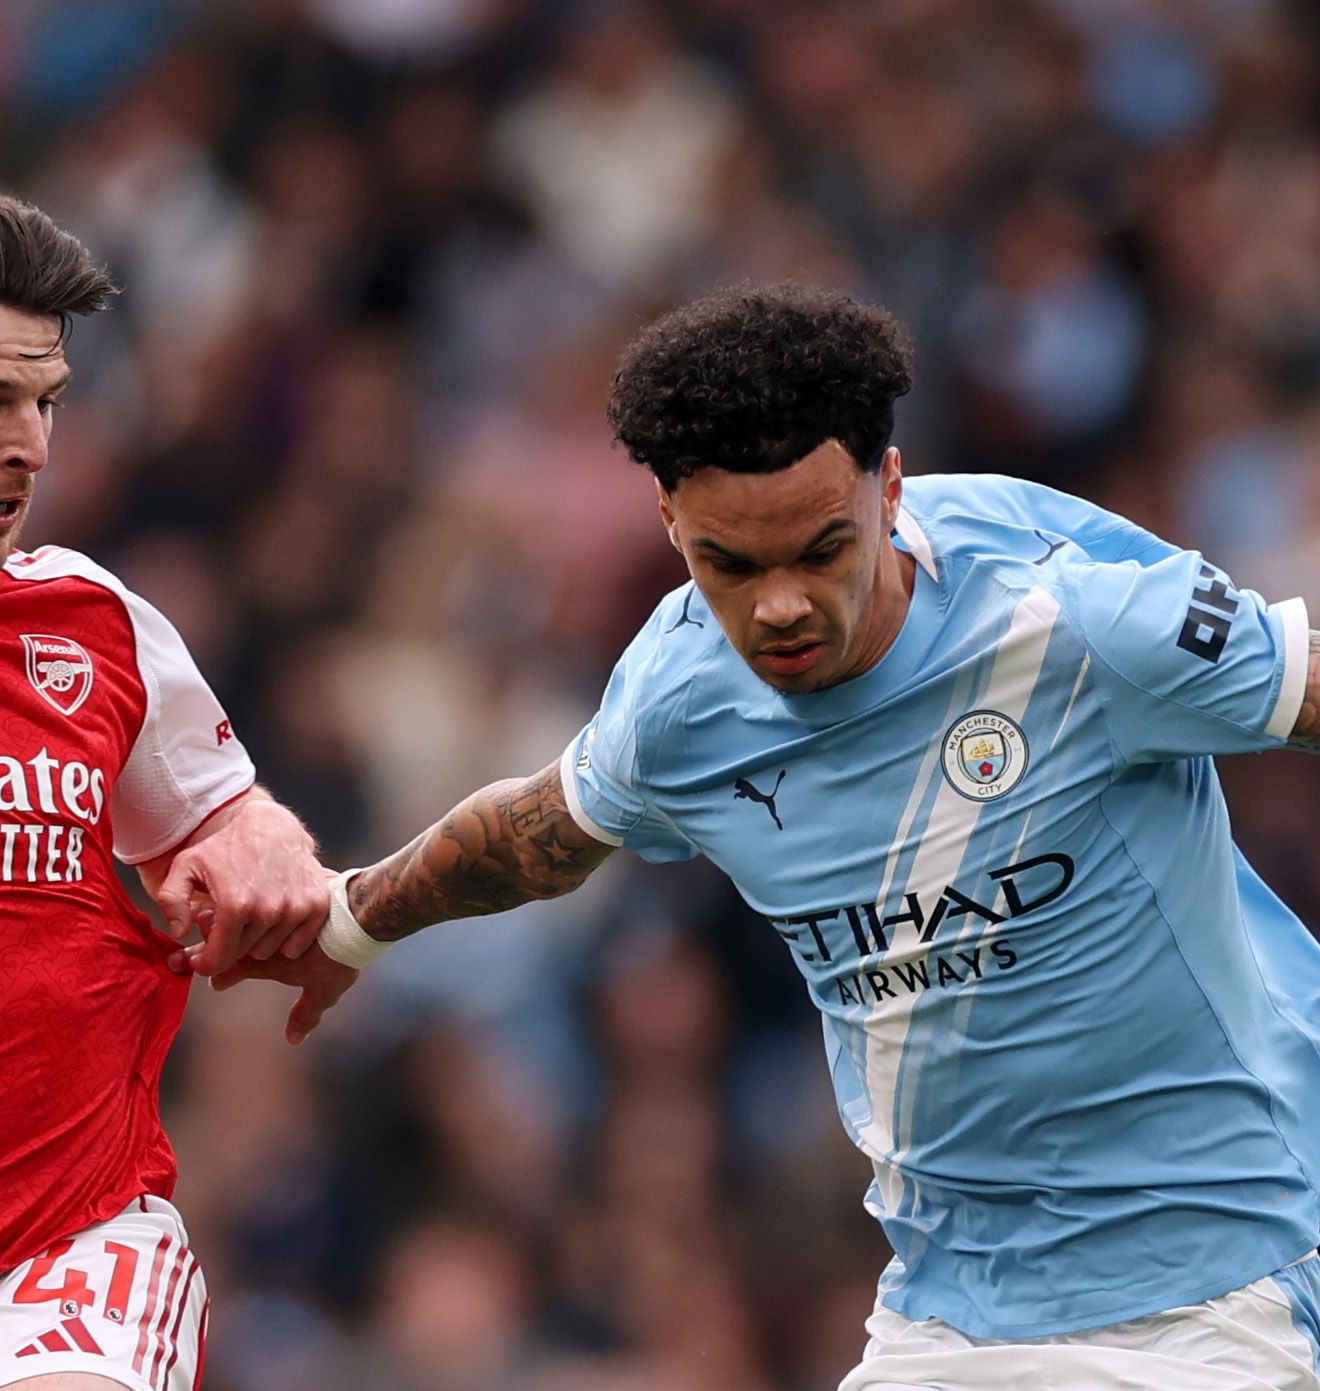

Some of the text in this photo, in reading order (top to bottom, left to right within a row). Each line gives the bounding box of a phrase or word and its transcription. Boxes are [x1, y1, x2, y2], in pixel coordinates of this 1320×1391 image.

[34, 640, 82, 656] Arsenal
[948, 716, 1016, 751] MANCHESTER
[977, 783, 1002, 796] CITY
[836, 939, 1018, 1006] AIRWAYS
[11, 1238, 140, 1326] 41
